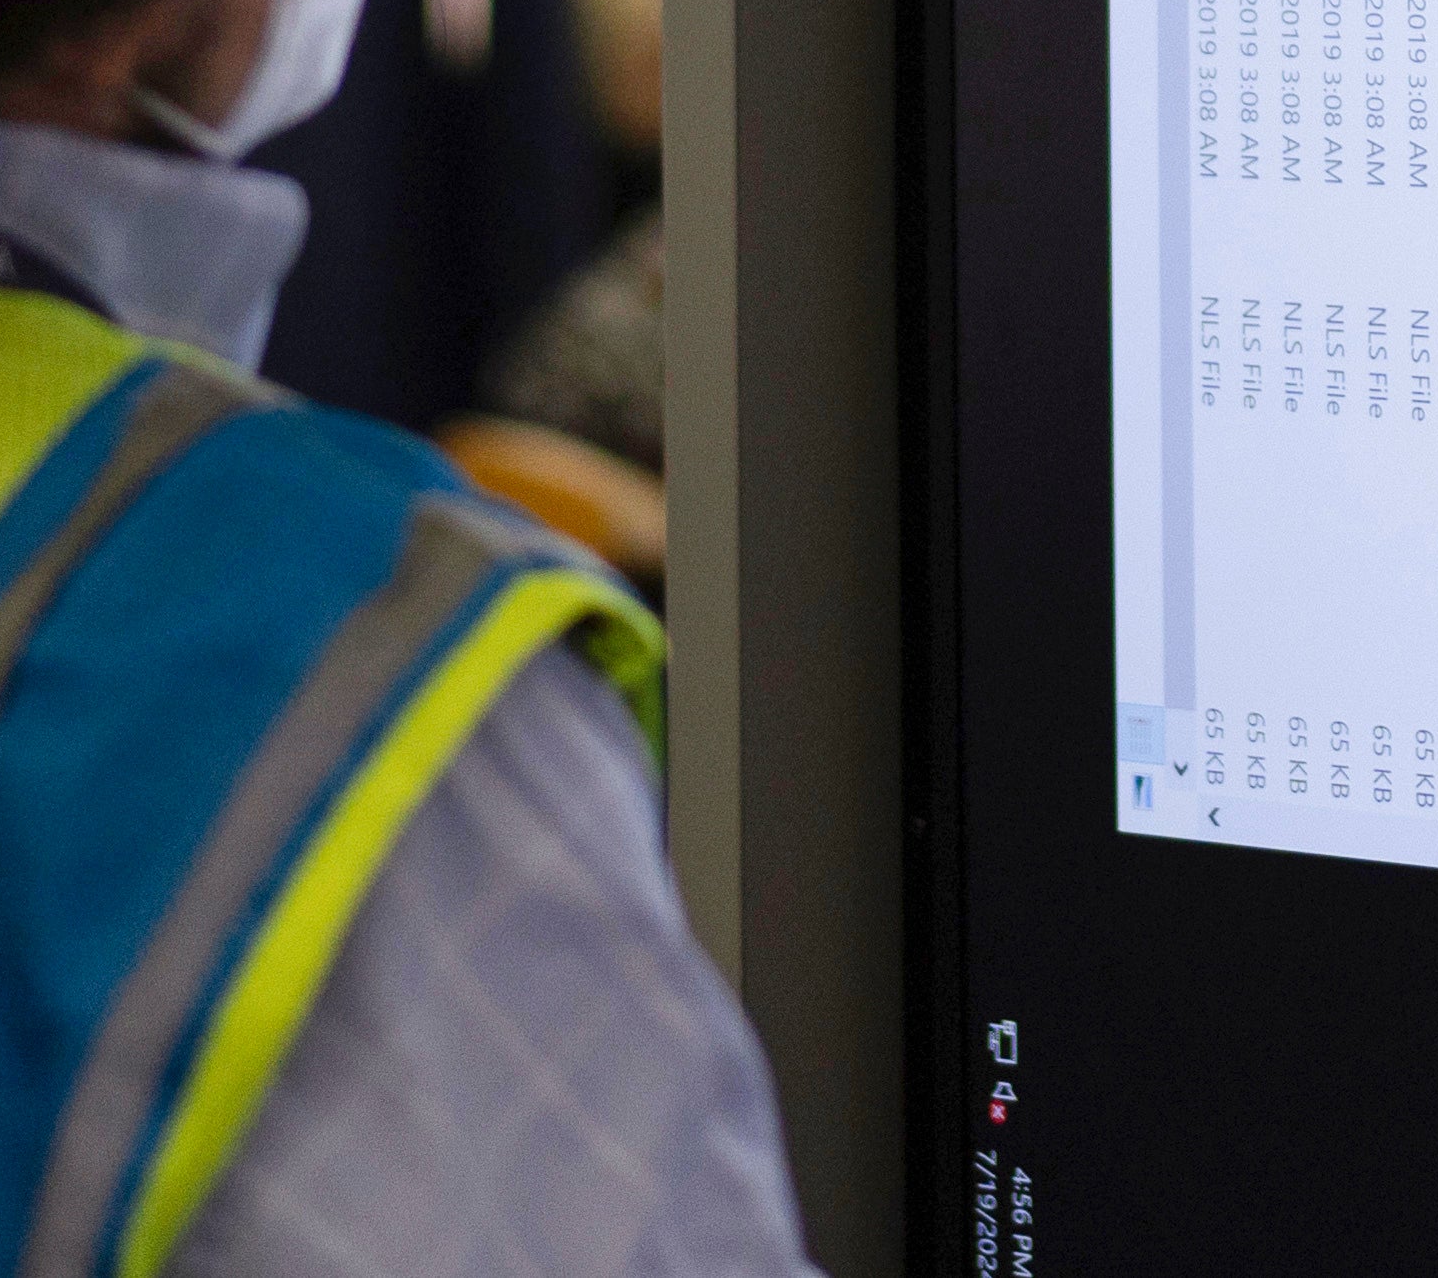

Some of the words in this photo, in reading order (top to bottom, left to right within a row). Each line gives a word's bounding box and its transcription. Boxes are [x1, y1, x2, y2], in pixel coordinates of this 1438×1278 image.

[1239, 68, 1260, 125] 3:08
[1240, 132, 1260, 181] AM
[1241, 298, 1262, 353] NLS
[1242, 362, 1263, 411] File
[1245, 711, 1266, 744] 65
[1246, 754, 1267, 791] KB
[1011, 1167, 1033, 1225] 4:56
[1012, 1233, 1033, 1278] PM
